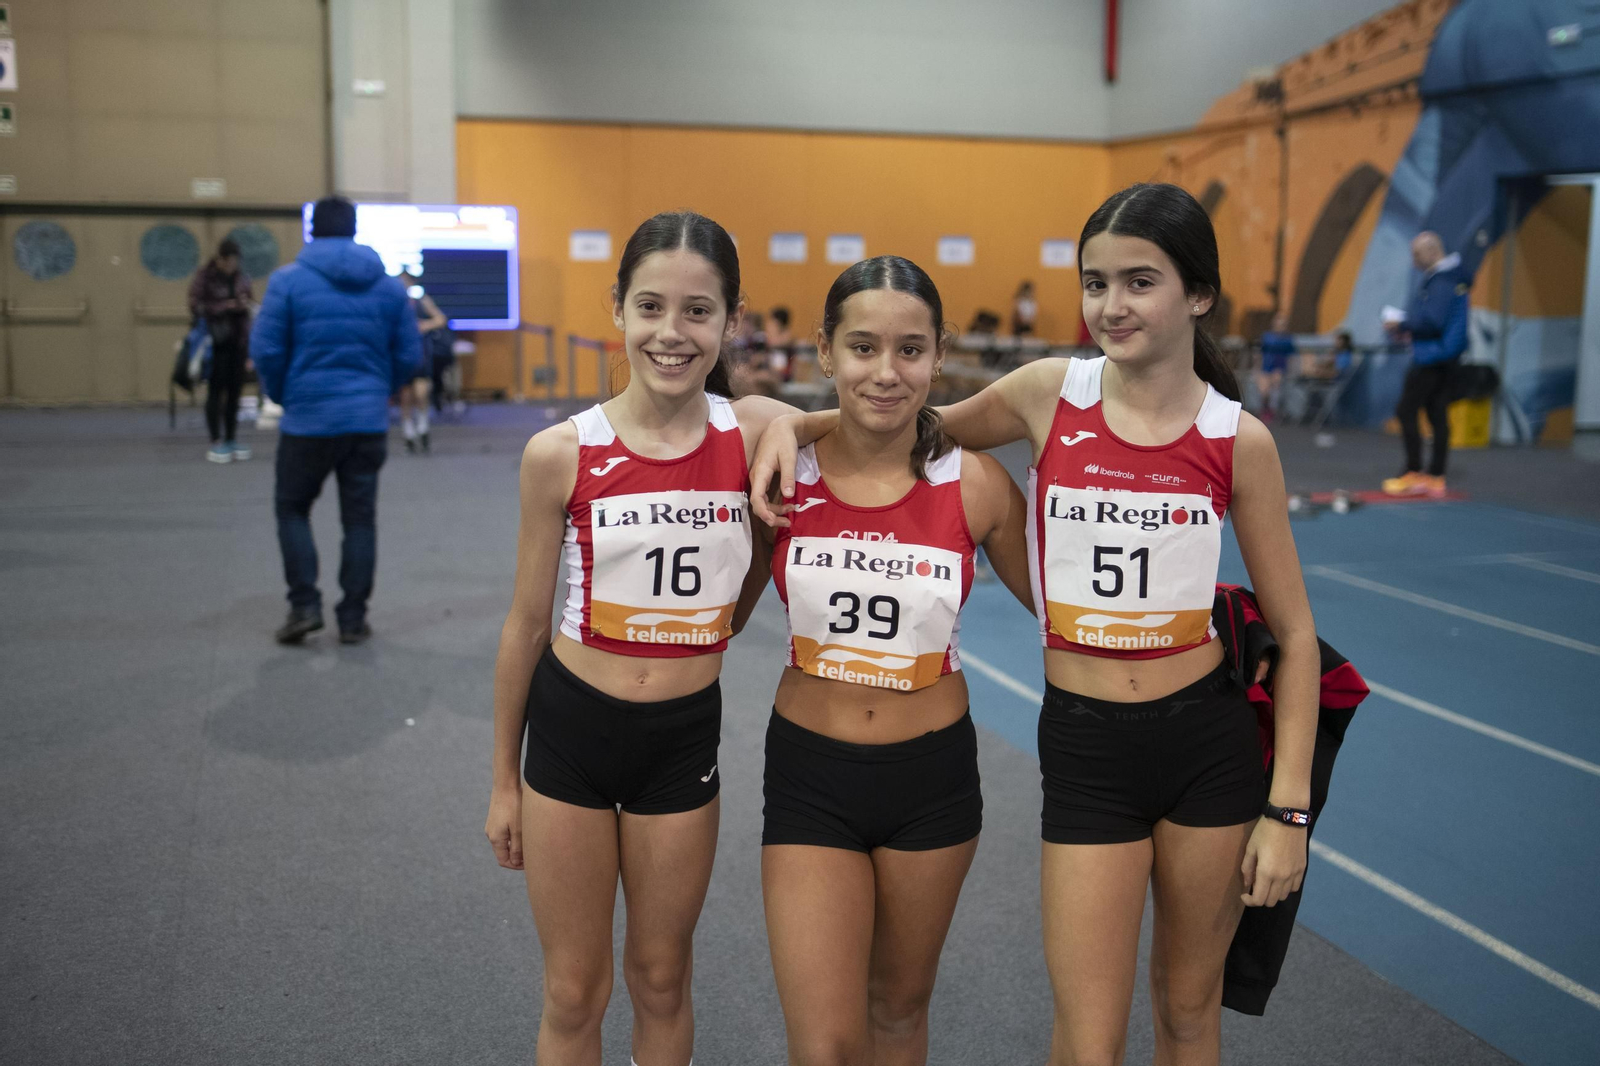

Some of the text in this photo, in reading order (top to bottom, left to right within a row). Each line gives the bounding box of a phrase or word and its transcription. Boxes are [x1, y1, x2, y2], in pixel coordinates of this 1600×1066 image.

[1100, 467, 1135, 480] Iberdrola
[595, 501, 743, 530] La Región
[1048, 495, 1210, 531] La Región
[645, 546, 702, 597] 16
[790, 545, 952, 581] La Región
[1092, 545, 1150, 599] 51
[829, 591, 900, 640] 39
[625, 626, 719, 645] telemiño
[1076, 627, 1173, 648] telemiño
[816, 660, 913, 691] telemiño
[1114, 709, 1159, 721] TENTH
